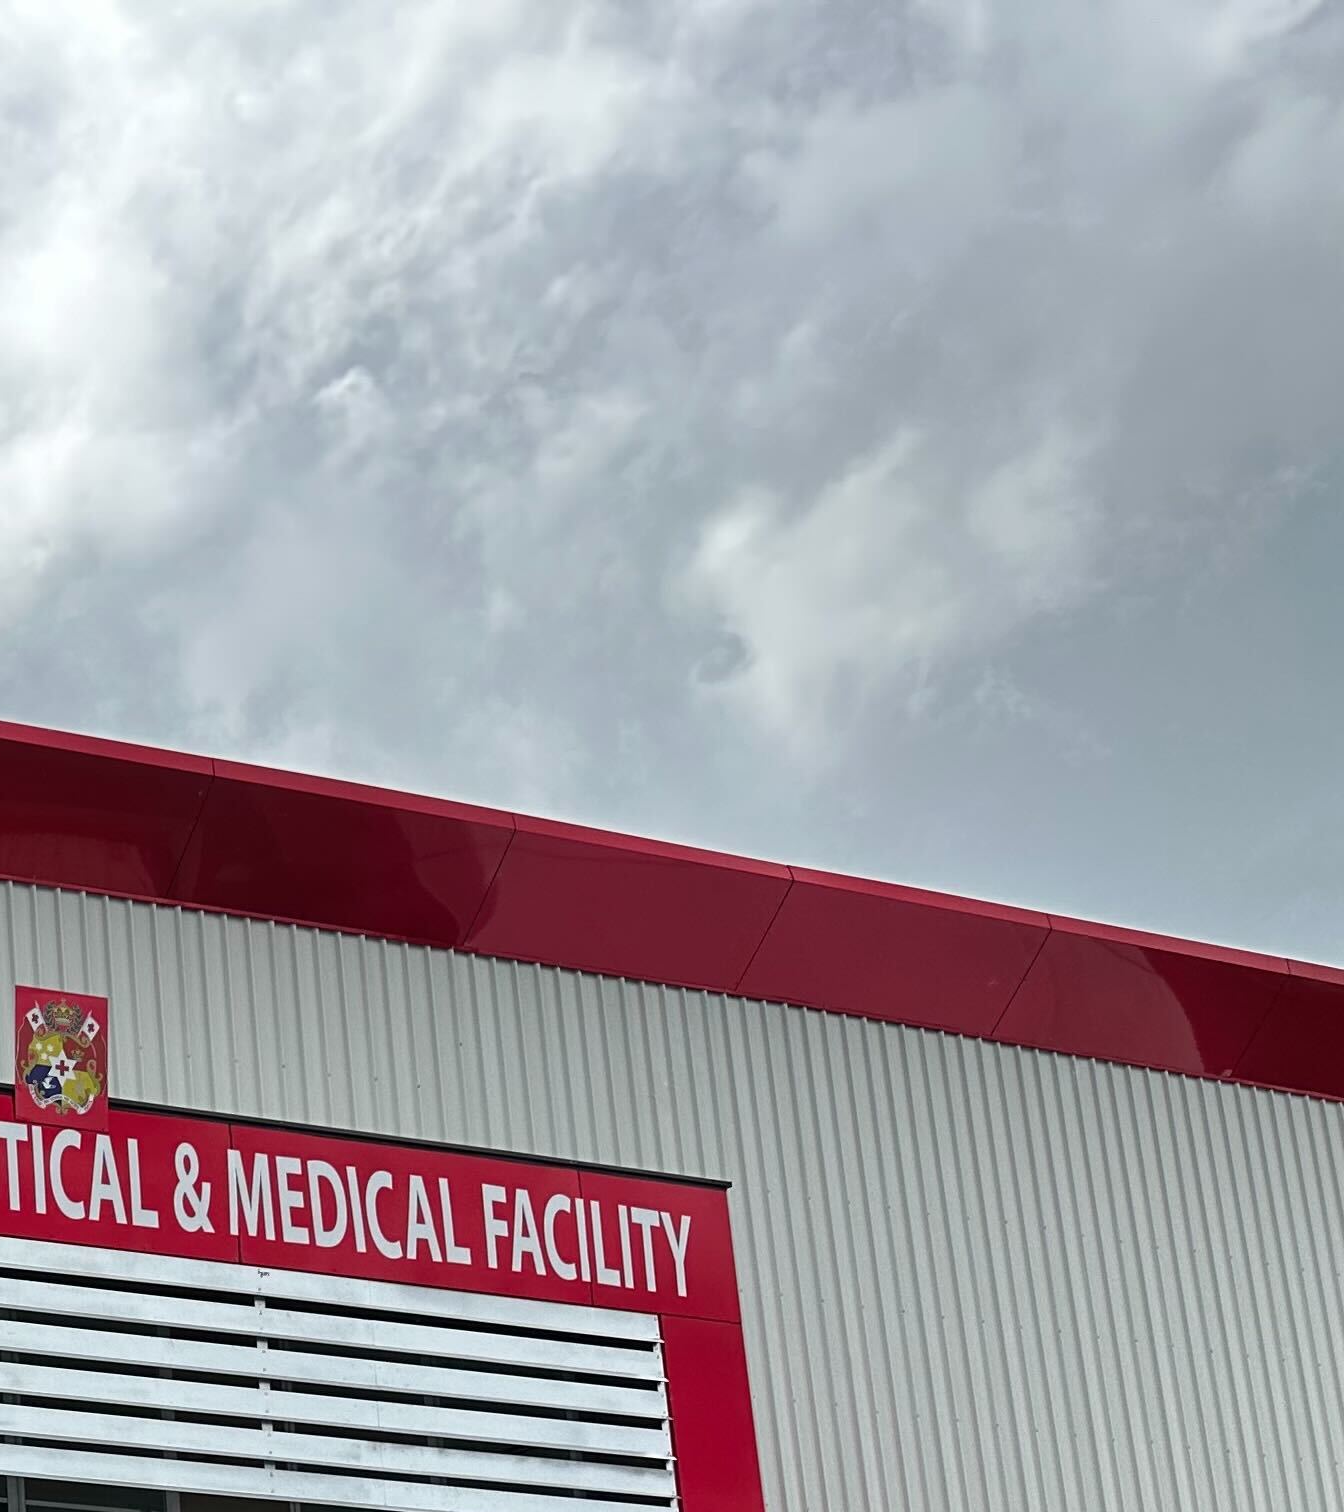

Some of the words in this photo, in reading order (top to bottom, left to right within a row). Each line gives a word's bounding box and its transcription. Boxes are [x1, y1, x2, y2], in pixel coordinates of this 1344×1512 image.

[173, 1142, 216, 1234] &
[226, 1148, 472, 1266] MEDICAL
[481, 1183, 692, 1298] FACILITY
